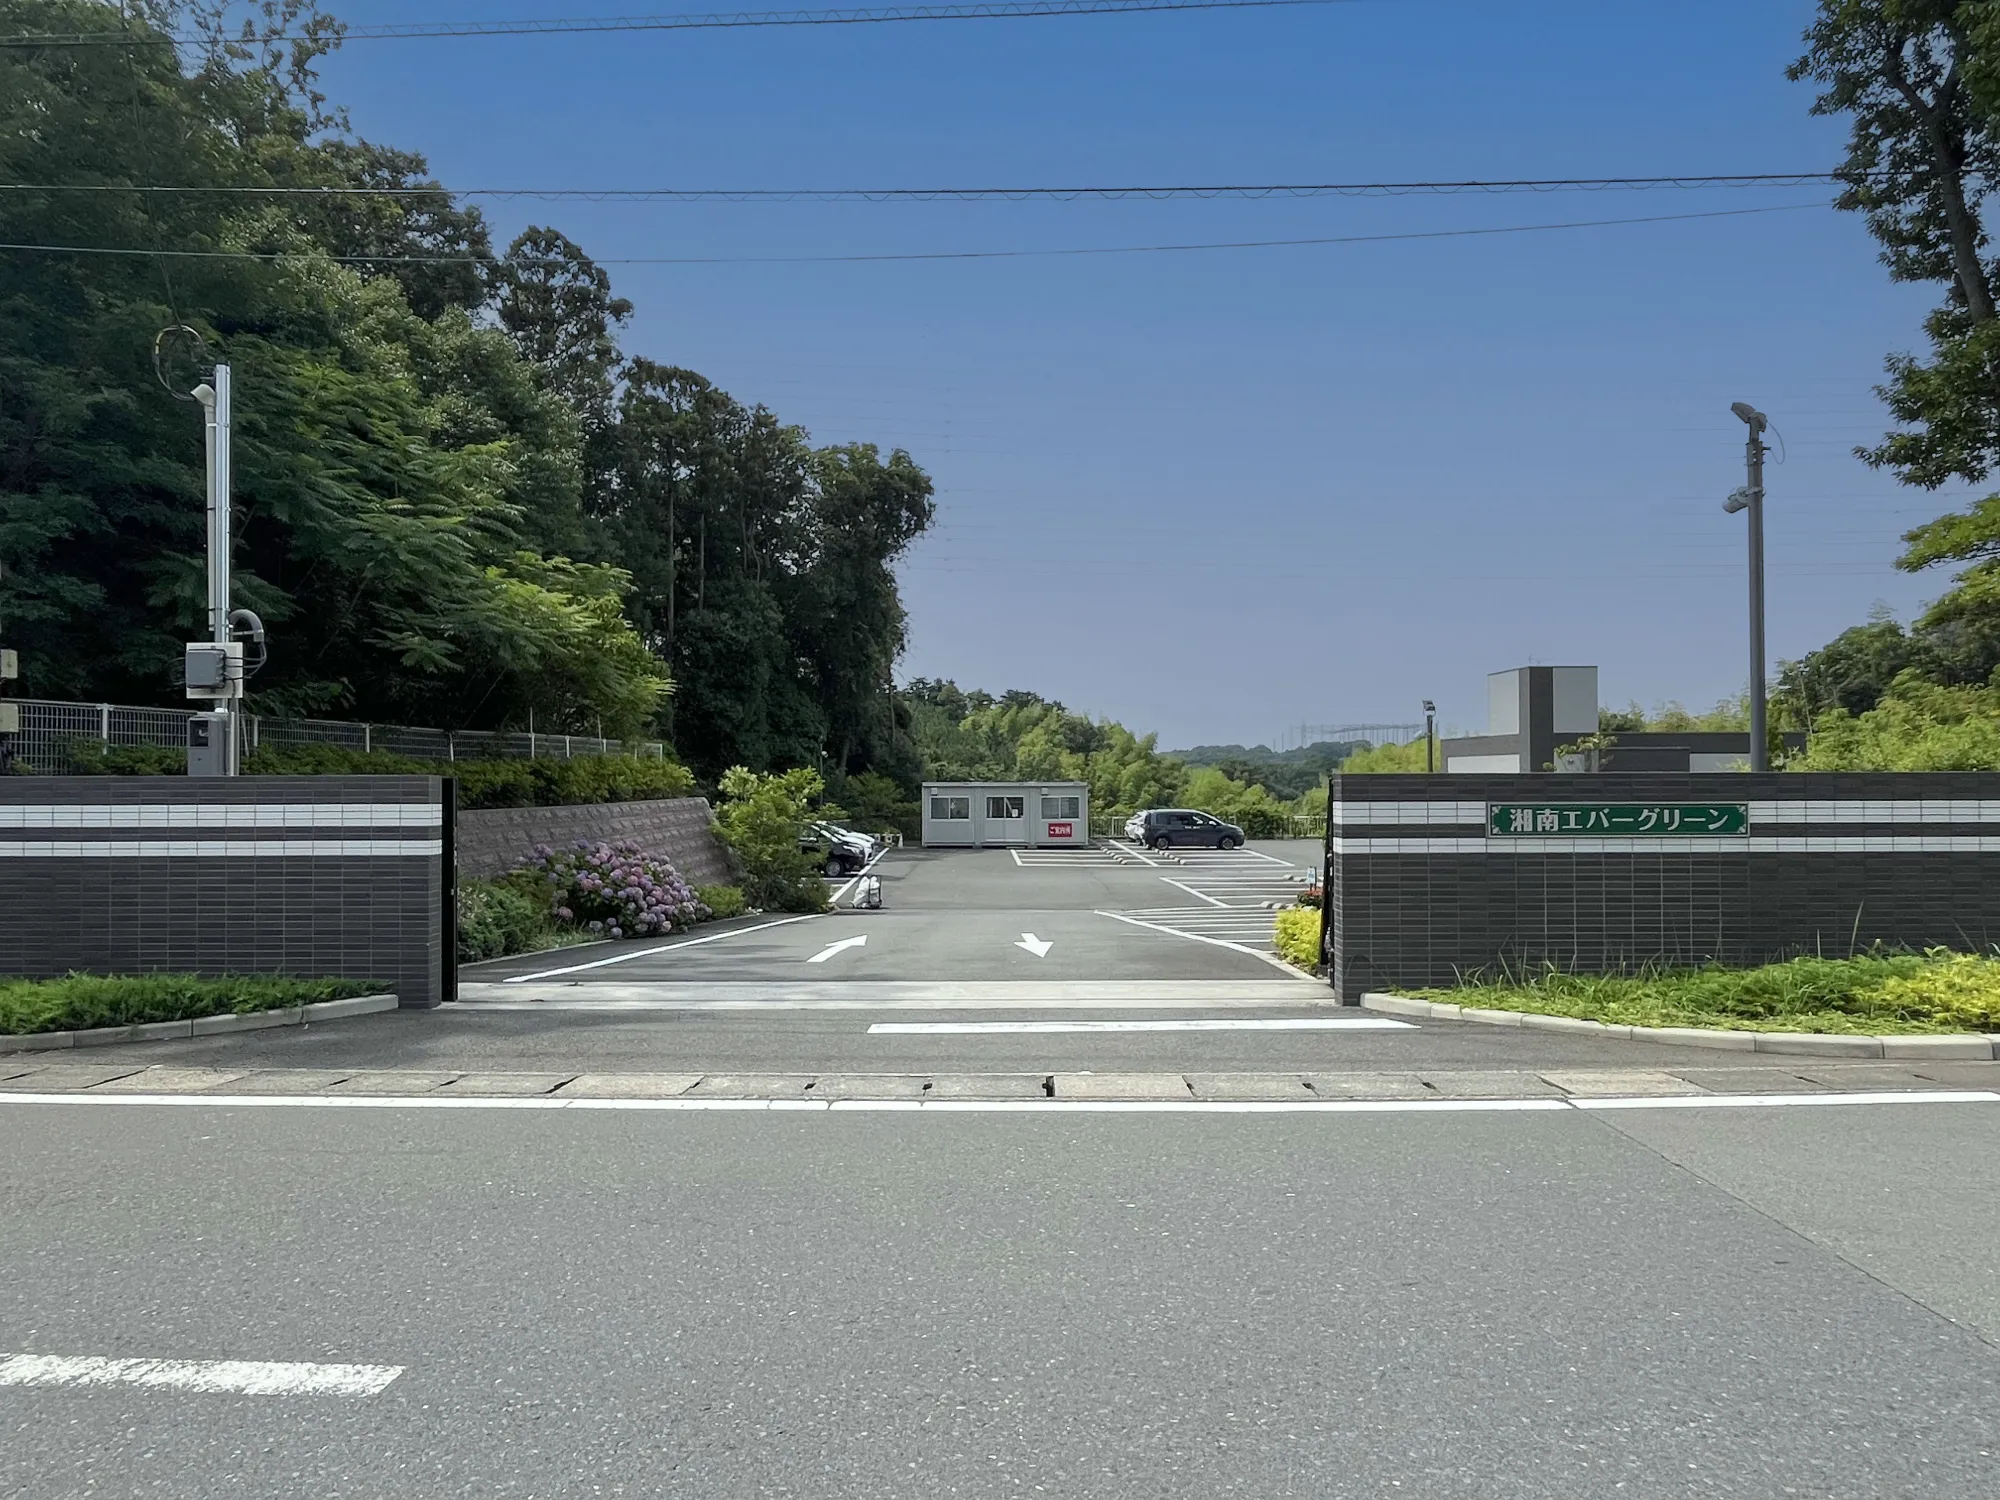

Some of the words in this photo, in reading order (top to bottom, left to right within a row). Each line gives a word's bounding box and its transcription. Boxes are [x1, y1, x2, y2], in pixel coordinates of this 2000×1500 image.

[1509, 808, 1729, 832] 湘南エバーグリーン
